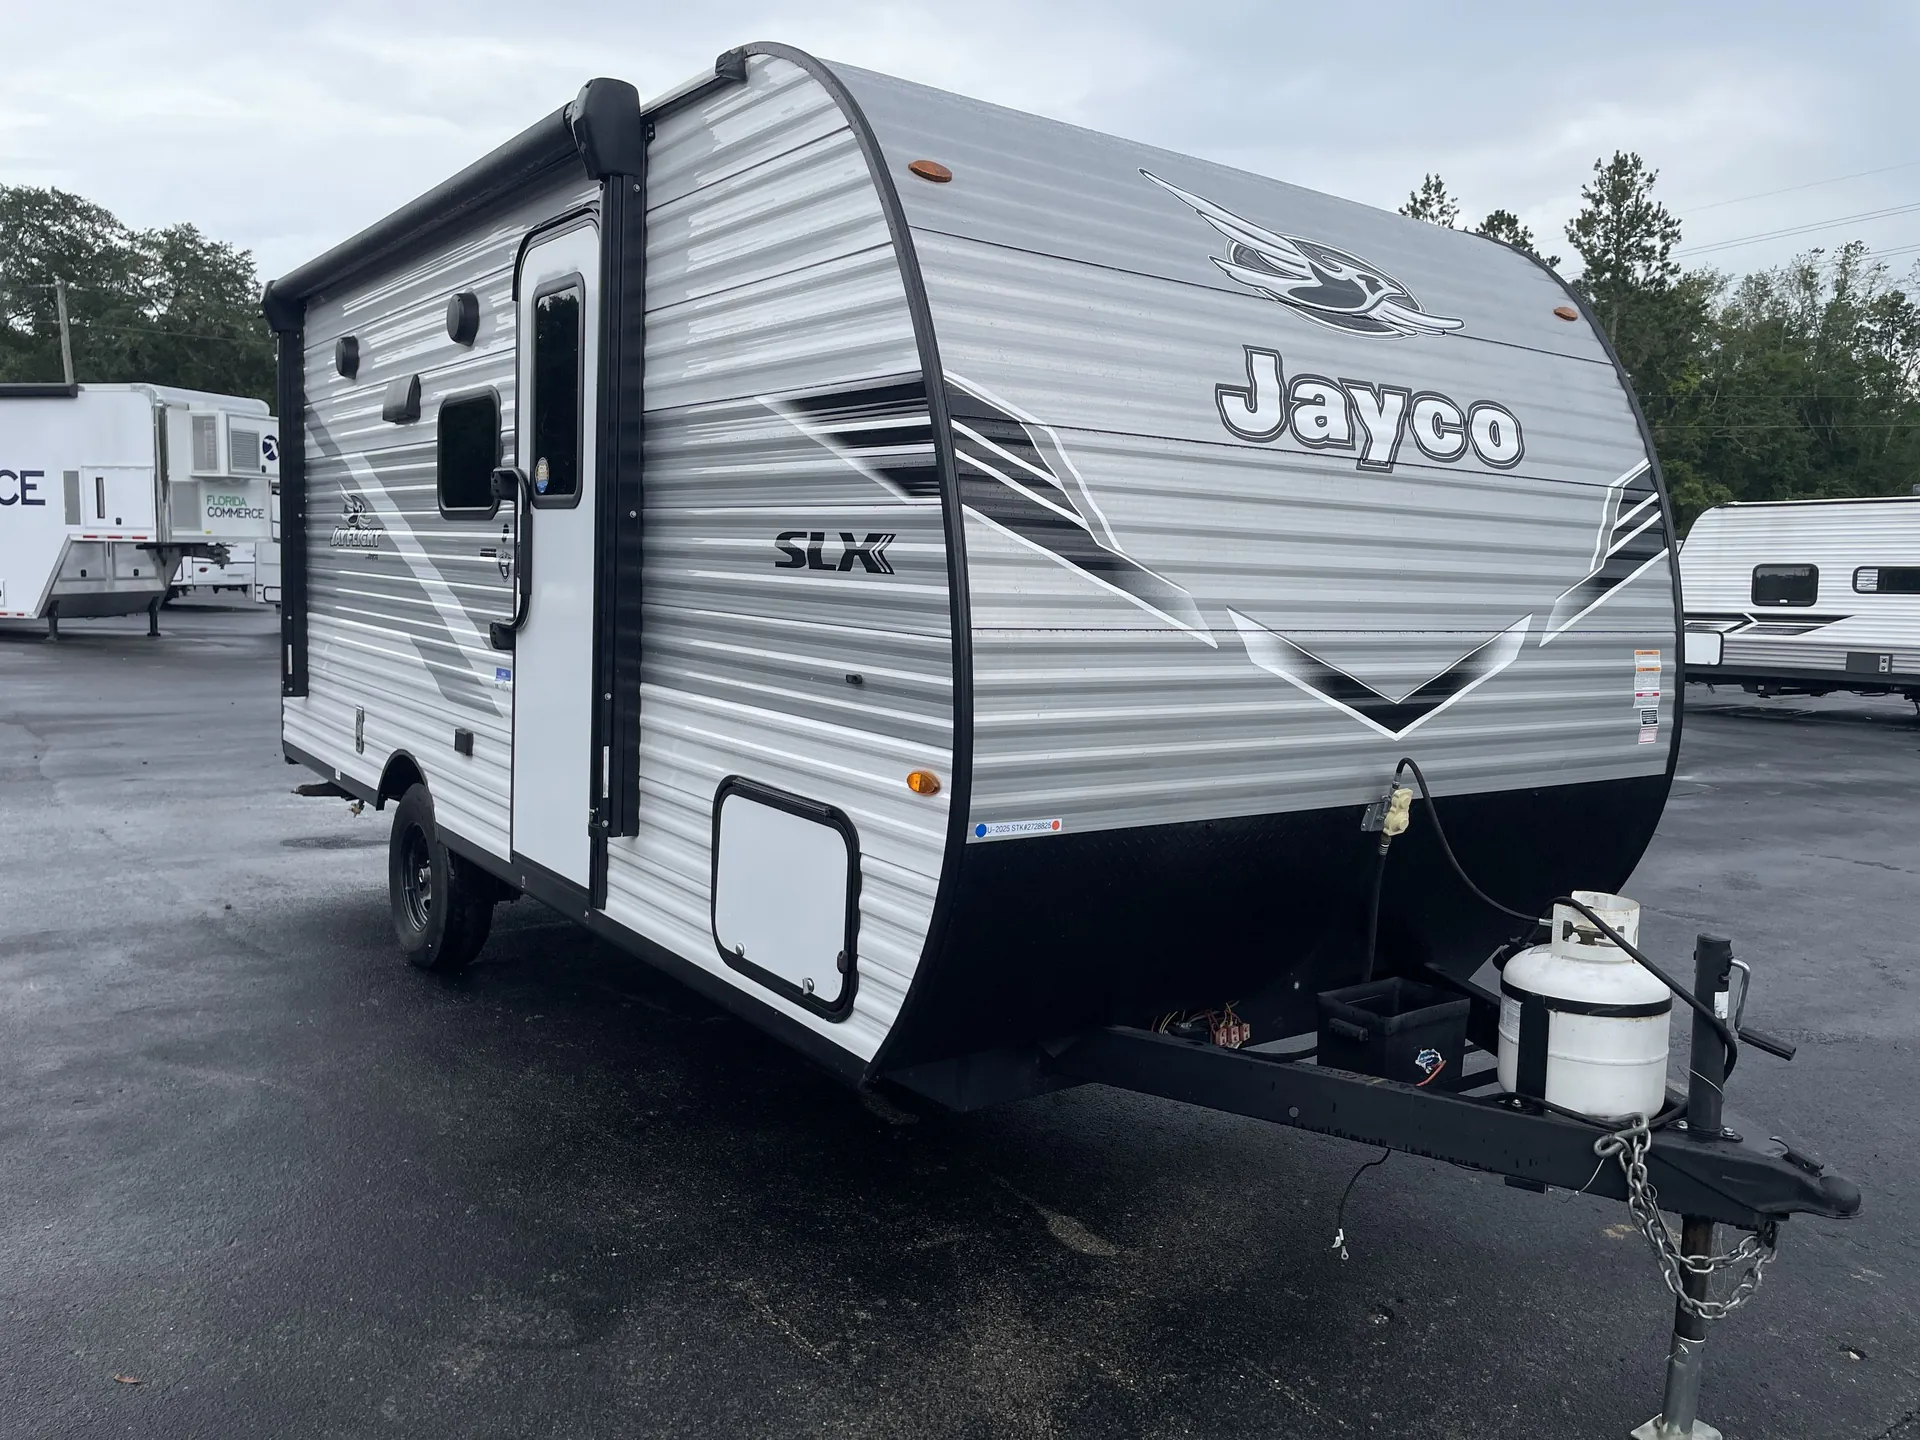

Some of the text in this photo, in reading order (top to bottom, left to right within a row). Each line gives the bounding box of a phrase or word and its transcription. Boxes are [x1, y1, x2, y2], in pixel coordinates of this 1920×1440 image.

[1214, 344, 1525, 473] Jayco
[206, 495, 247, 507] FLORIDA
[207, 506, 265, 519] COMMERCE
[774, 531, 897, 575] SLX
